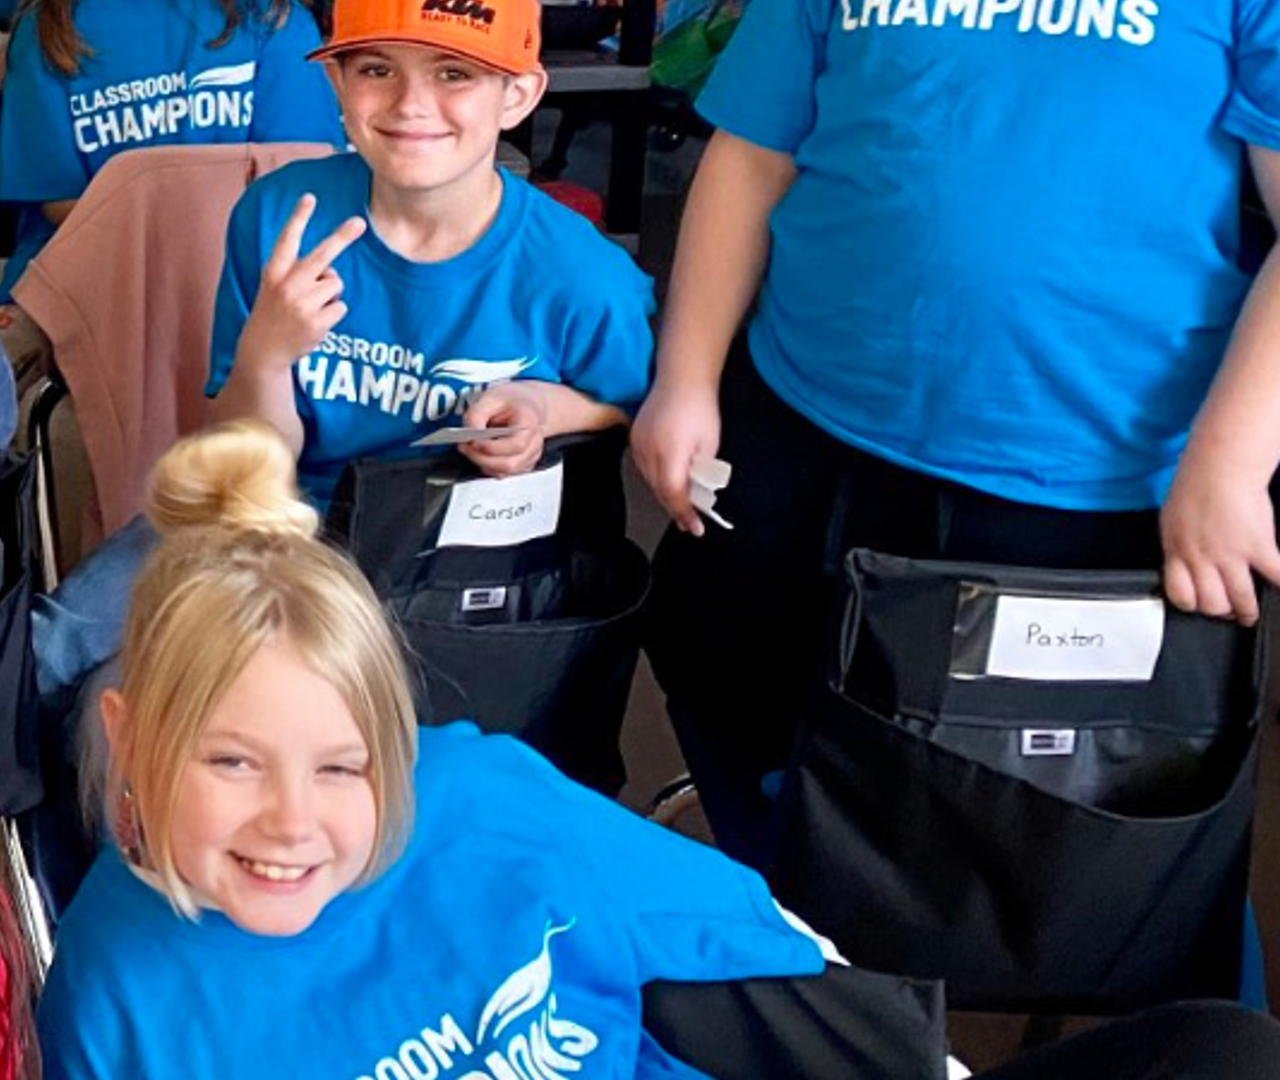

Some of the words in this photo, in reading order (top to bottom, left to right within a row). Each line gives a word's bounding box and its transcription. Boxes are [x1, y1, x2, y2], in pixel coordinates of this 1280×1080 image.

[69, 70, 187, 116] CLASSROOM
[73, 90, 255, 153] CHAMPIONS
[314, 331, 426, 376] SSROOM
[467, 500, 533, 523] Carson
[1025, 622, 1105, 649] Paxton
